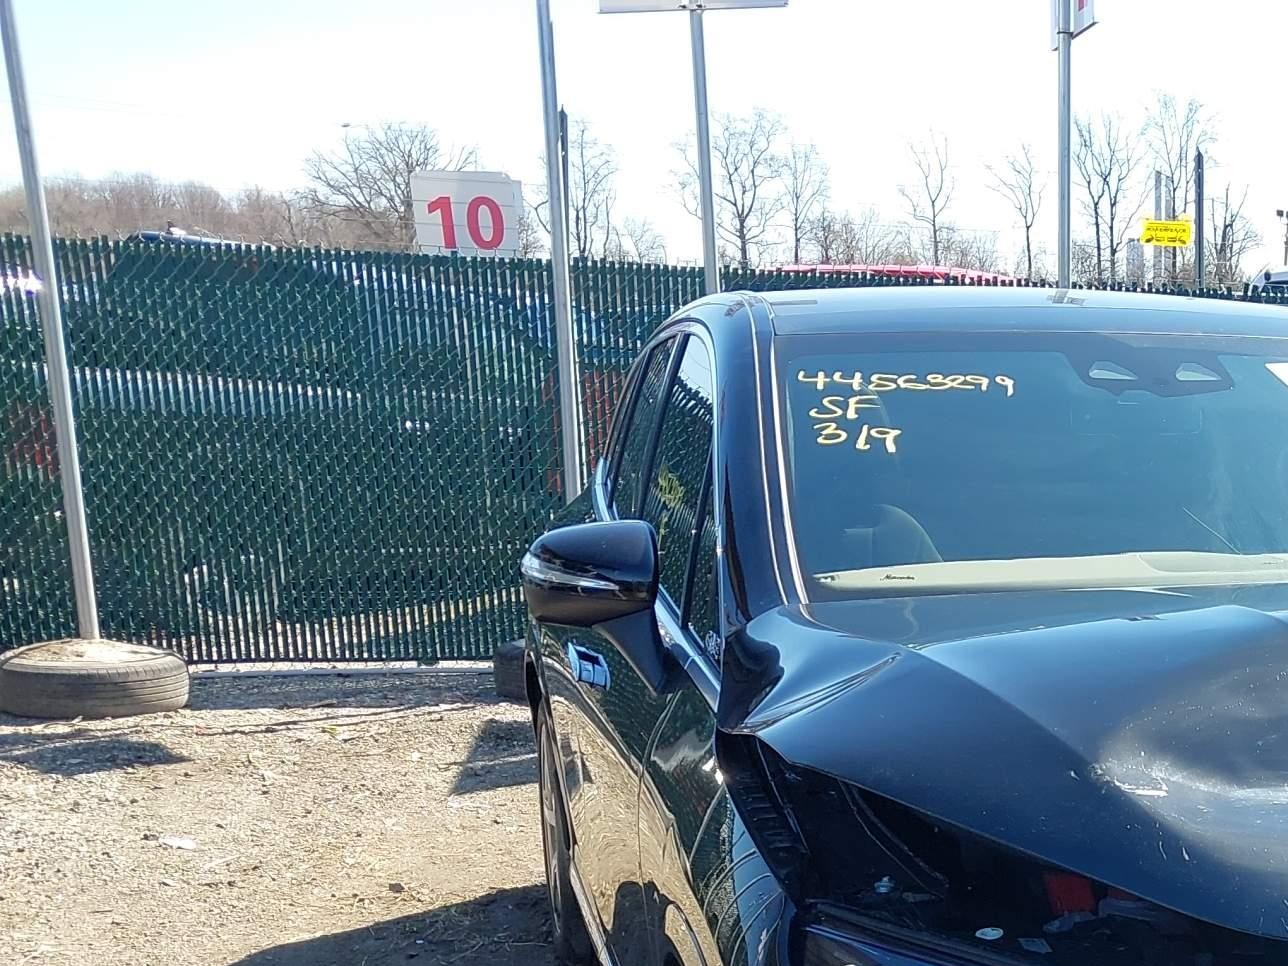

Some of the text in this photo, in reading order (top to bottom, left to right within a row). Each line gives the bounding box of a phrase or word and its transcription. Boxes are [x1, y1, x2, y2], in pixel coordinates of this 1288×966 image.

[428, 195, 505, 251] 10
[797, 369, 1015, 398] 44563299
[808, 395, 881, 420] SF
